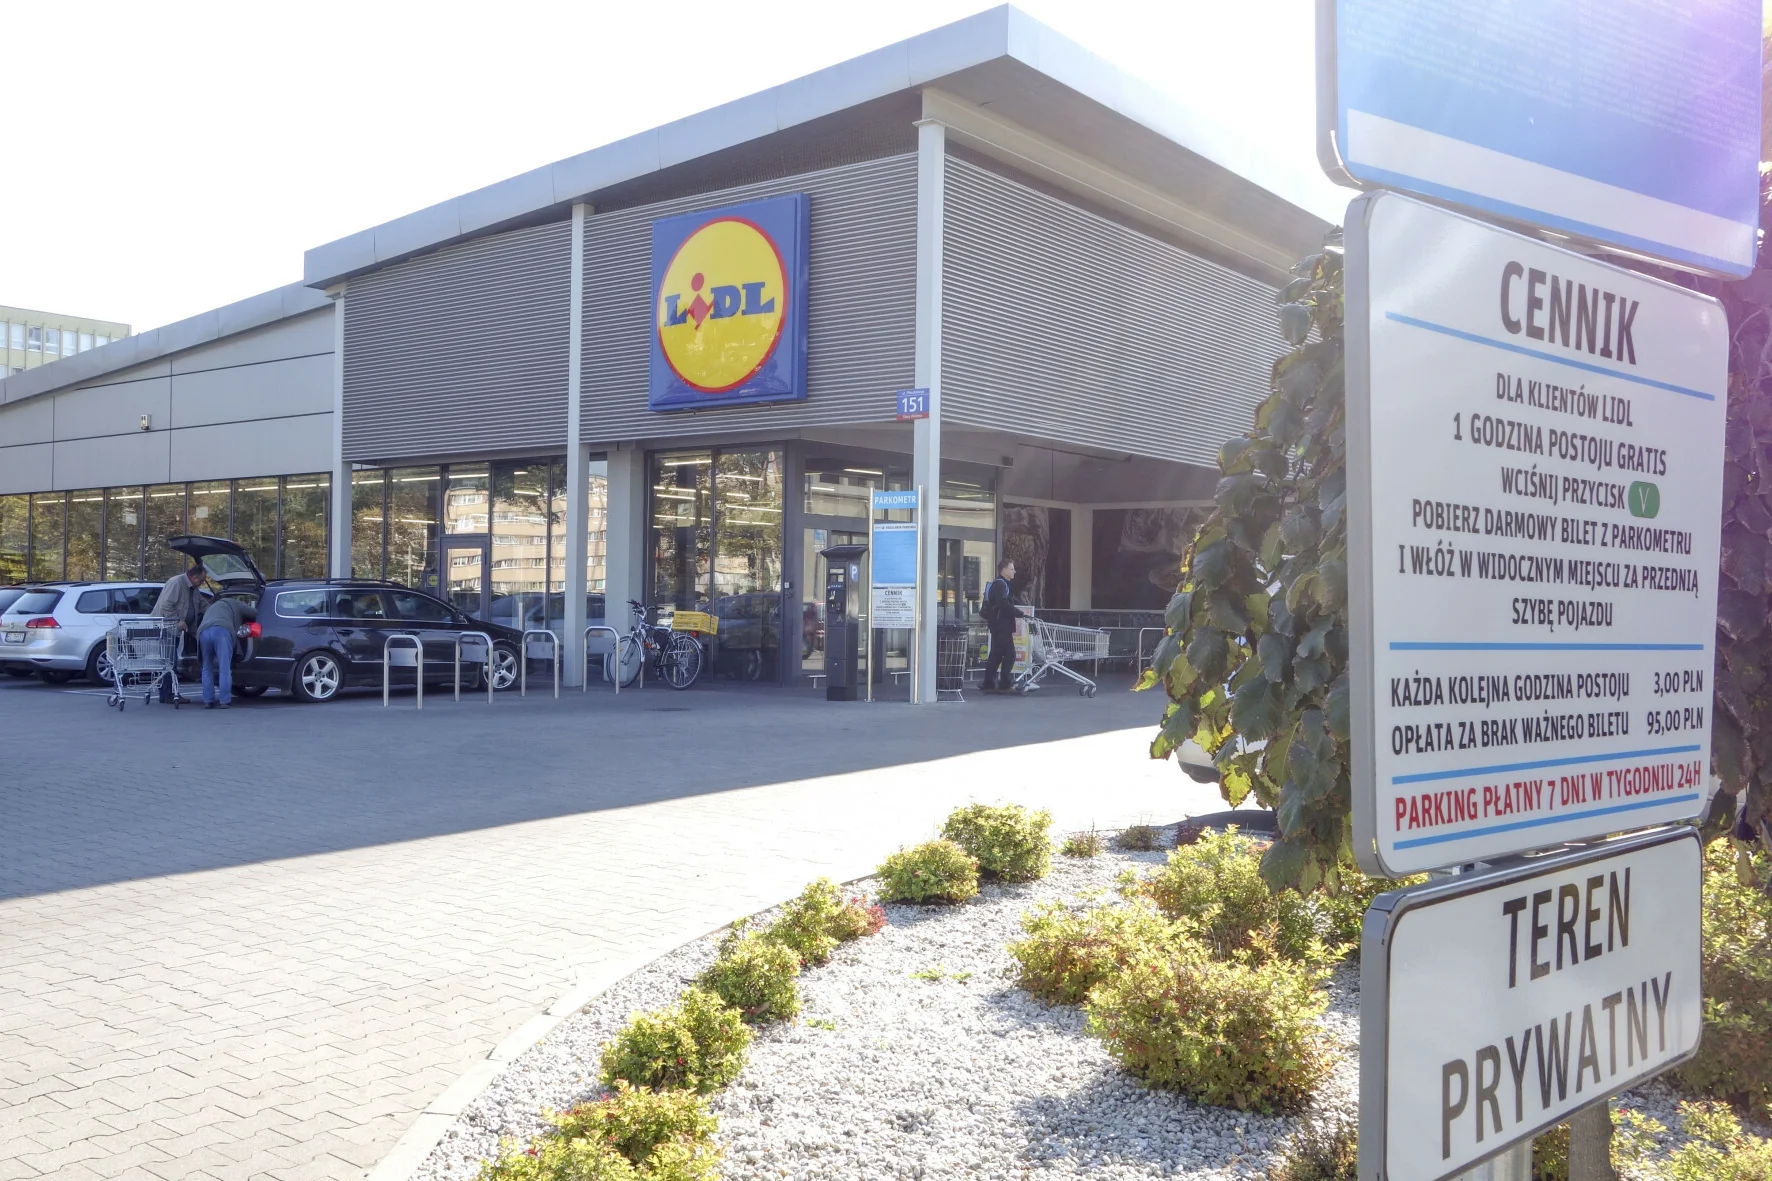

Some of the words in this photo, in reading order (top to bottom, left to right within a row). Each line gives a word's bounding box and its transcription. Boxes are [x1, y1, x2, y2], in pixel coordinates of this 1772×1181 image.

[1500, 261, 1639, 365] CENNIK
[902, 396, 924, 413] 151
[1496, 372, 1524, 405] DLA
[1528, 380, 1599, 421] KLIENTÓW
[1602, 395, 1633, 427] LIDL
[1453, 412, 1463, 441] 1
[1470, 413, 1544, 456] GODZINA
[1549, 428, 1613, 472] POSTOJU
[1617, 442, 1667, 476] GRATIS
[874, 495, 917, 505] PARKOMETR
[1501, 464, 1559, 505] WCIŚNIJ
[1563, 478, 1626, 509] PRZYCISK
[1412, 498, 1480, 535] POBIERZ
[1485, 509, 1557, 542] DARMOWY
[1561, 516, 1598, 544] BILET
[1601, 523, 1608, 546] Z
[1611, 524, 1692, 555] PARKOMETRU
[1399, 544, 1406, 574] I
[1410, 538, 1455, 577] WŁÓŻ
[1459, 550, 1473, 578] W
[1478, 552, 1565, 584] WIDOCZNYM
[1568, 559, 1620, 592] MIEJSCU
[1623, 564, 1639, 589] ZA
[1641, 565, 1700, 599] PRZEDNIĄ
[1512, 597, 1555, 633] SZYBĘ
[1558, 600, 1613, 631] POJAZDU
[1391, 669, 1444, 707] KAŻDA
[1448, 675, 1510, 709] KOLEJNA
[1514, 673, 1574, 703] GODZINA
[1577, 672, 1630, 701] POSTOJU
[1653, 671, 1680, 698] 3,00
[1684, 670, 1703, 693] PLN
[1391, 723, 1454, 756] OPŁATA
[1458, 721, 1477, 750] ZA
[1481, 717, 1519, 747] BRAK
[1522, 709, 1584, 744] WAŻNEGO
[1588, 709, 1630, 738] BILETU
[1646, 709, 1680, 738] 95,00
[1684, 706, 1704, 730] PLN
[1395, 788, 1478, 832] PARKING
[1484, 782, 1542, 817] PŁATNY
[1547, 780, 1557, 812] 7
[1561, 775, 1587, 806] DNI
[1590, 772, 1604, 802] W
[1607, 764, 1675, 798] TYGODNIU
[1677, 759, 1701, 789] 24H
[1502, 866, 1632, 988] TEREN
[1441, 971, 1673, 1160] PRYWATNY
